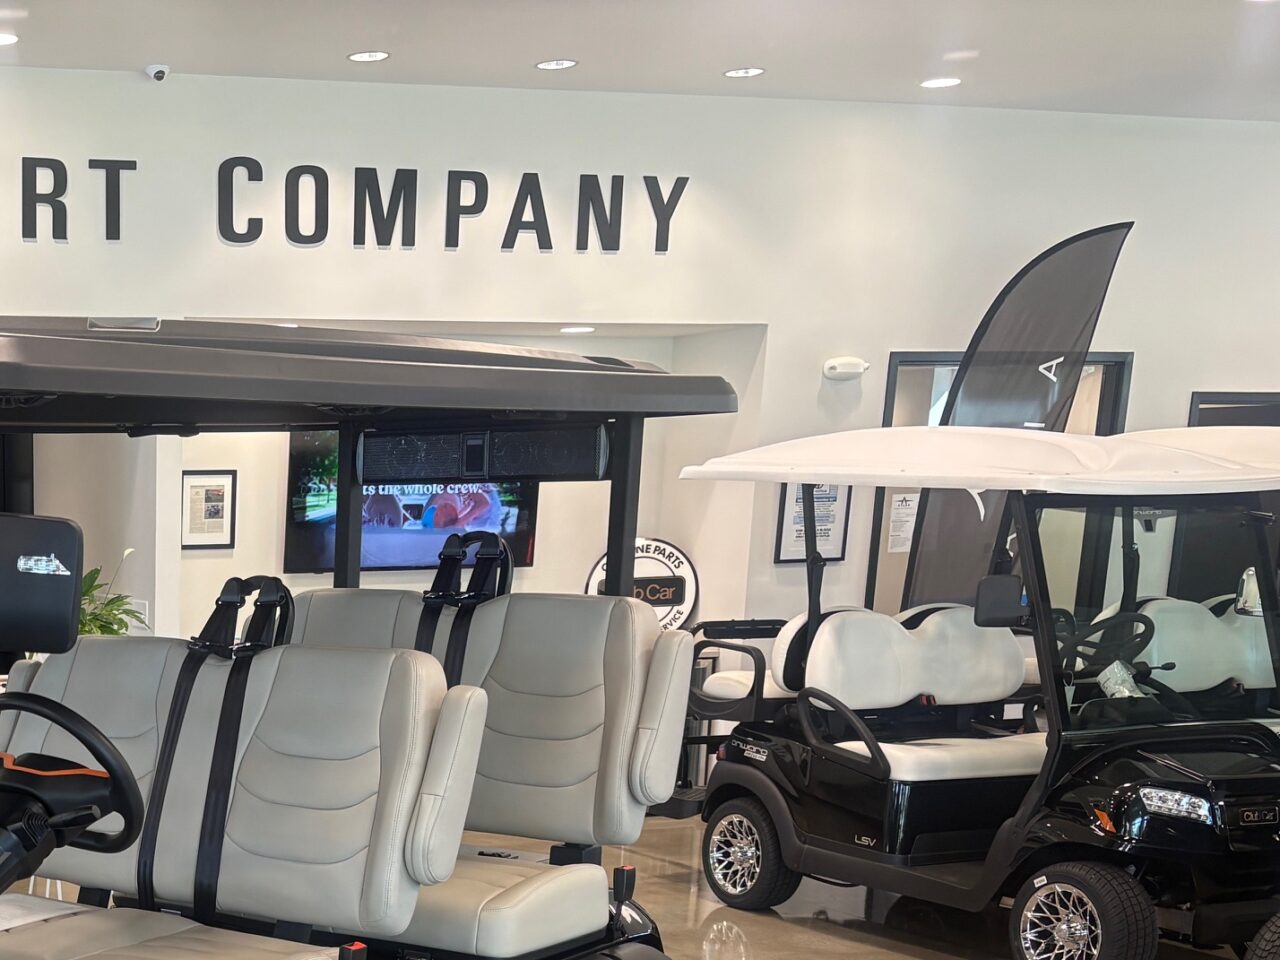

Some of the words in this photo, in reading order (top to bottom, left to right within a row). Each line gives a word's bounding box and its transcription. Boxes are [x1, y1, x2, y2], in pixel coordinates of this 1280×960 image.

[219, 157, 691, 253] COMPANY
[378, 484, 401, 495] the
[404, 484, 445, 495] whole
[447, 484, 482, 494] crew.
[653, 545, 684, 569] PARTS
[646, 584, 676, 600] Car
[661, 609, 684, 632] RVICE
[855, 834, 876, 846] LSV
